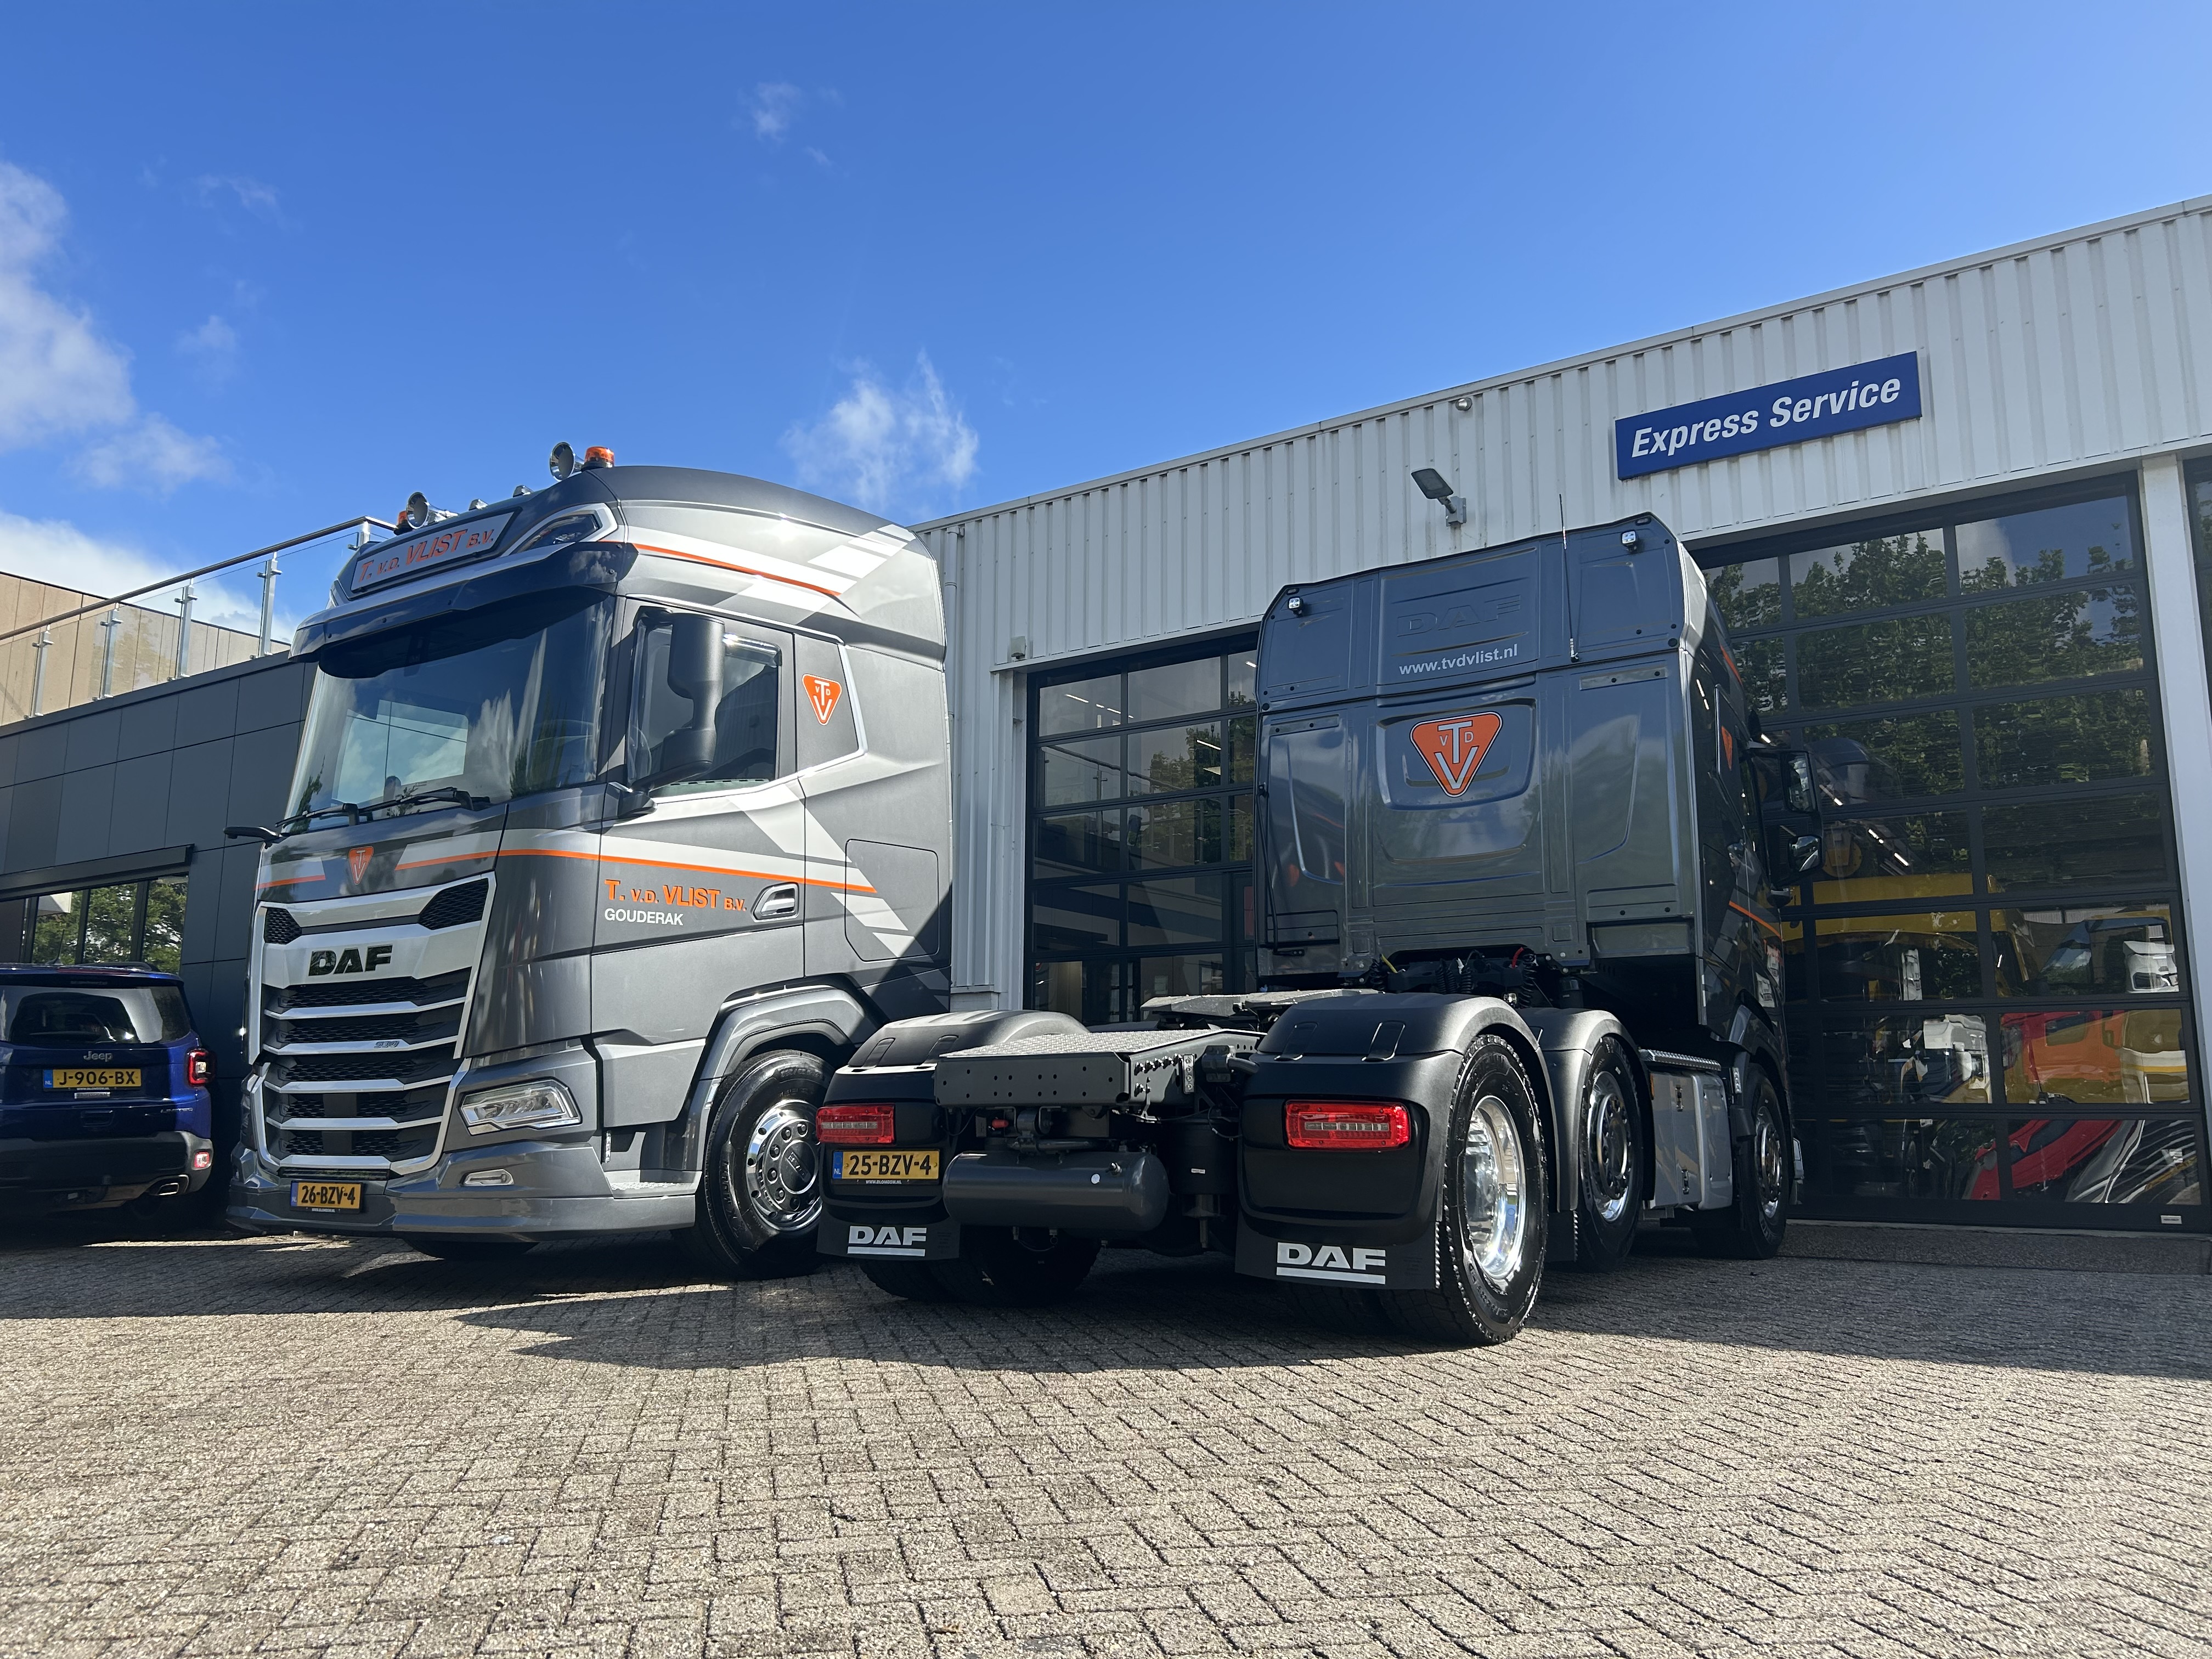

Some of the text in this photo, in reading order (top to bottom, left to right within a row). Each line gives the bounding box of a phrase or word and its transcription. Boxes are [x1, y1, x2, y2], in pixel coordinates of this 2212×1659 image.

[1631, 378, 1901, 456] Express Service
[358, 560, 374, 583] T.
[405, 528, 468, 567] VLIST
[466, 529, 495, 549] B.V.
[1397, 594, 1521, 637] DAF
[1399, 643, 1518, 675] www.tvdvlist.nl
[604, 879, 625, 901] T.
[663, 884, 721, 909] VLIST
[724, 896, 747, 912] B.V.
[605, 908, 684, 926] GOUDERAK
[308, 944, 393, 976] DAF
[83, 1051, 113, 1062] Jeep
[59, 1071, 136, 1085] J-906-BX
[849, 1154, 932, 1175] 25-BZV-4
[301, 1185, 356, 1205] 26-BZV-4
[849, 1226, 927, 1246] DAF
[1277, 1242, 1386, 1271] DAF
